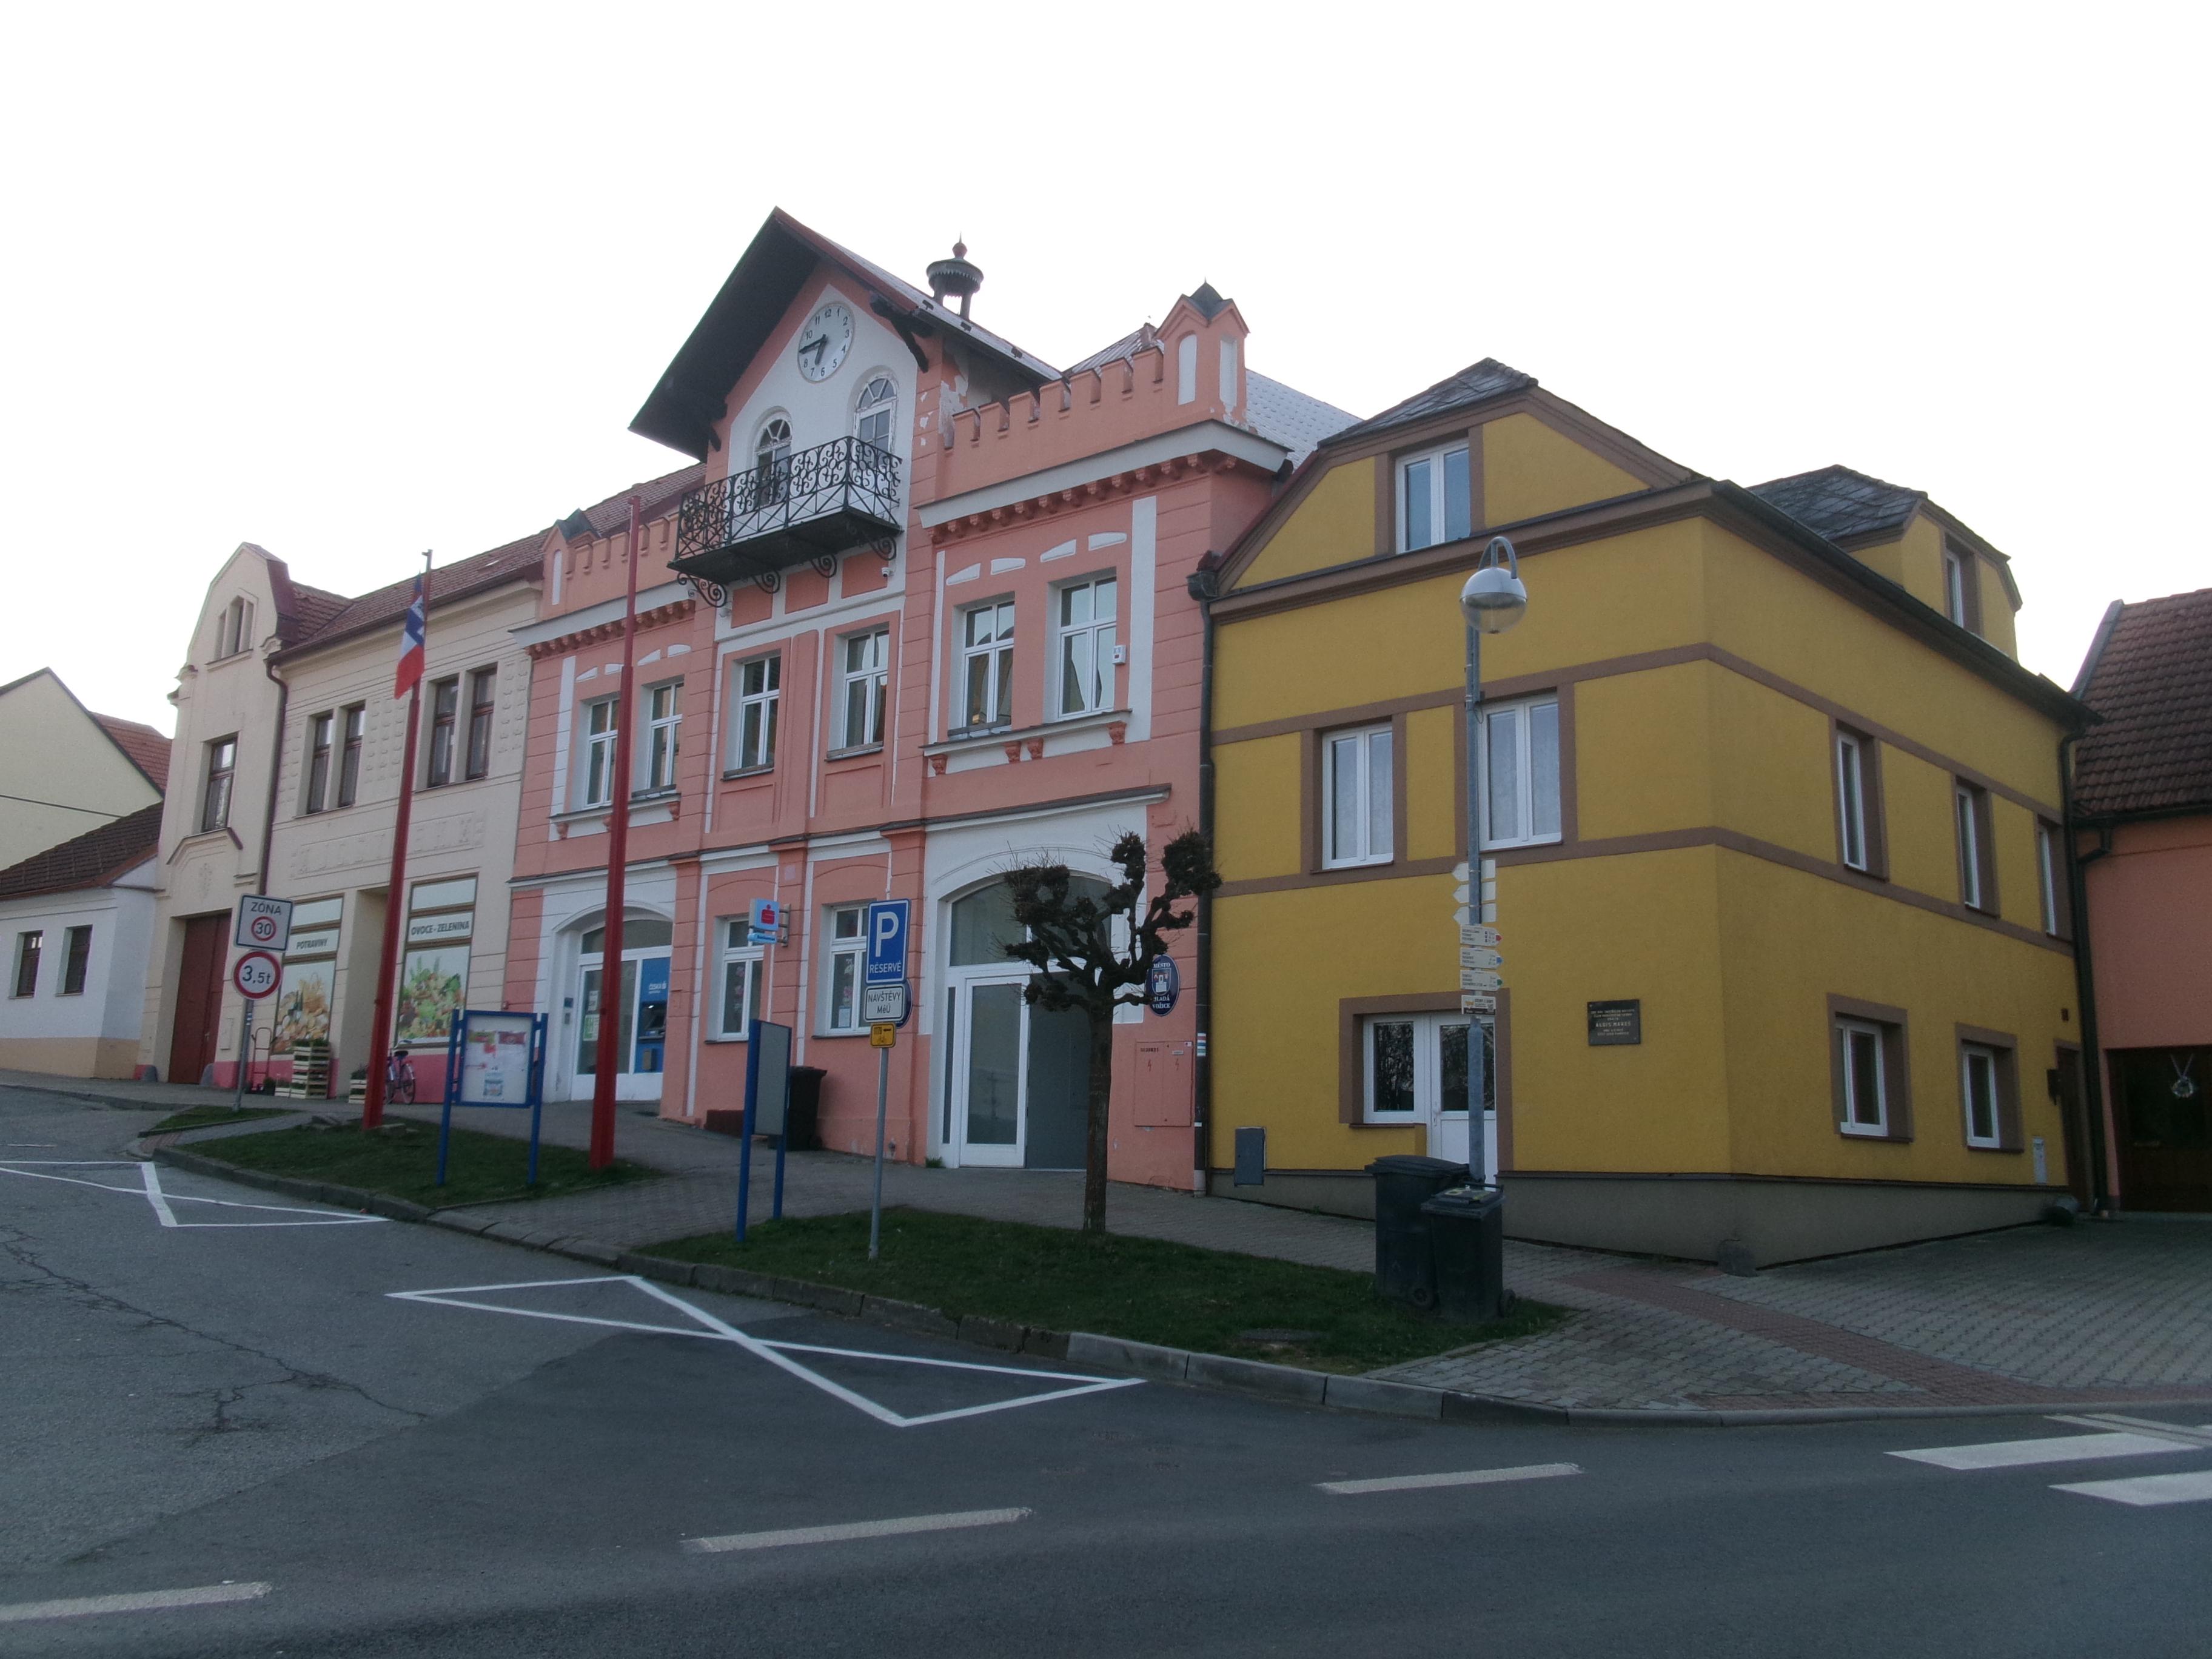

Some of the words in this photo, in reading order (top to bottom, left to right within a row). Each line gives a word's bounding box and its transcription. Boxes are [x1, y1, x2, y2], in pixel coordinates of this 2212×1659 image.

[825, 309, 832, 318] 12
[836, 307, 840, 317] 1
[814, 316, 820, 325] 11
[843, 317, 848, 326] 2
[805, 330, 813, 340] 10
[845, 329, 850, 338] 3
[841, 344, 846, 354] 4
[803, 358, 808, 368] 8
[833, 358, 837, 368] 5
[810, 367, 815, 377] 7
[820, 367, 825, 377] 6
[250, 902, 282, 916] ZÓNA
[255, 922, 272, 936] 30
[411, 925, 433, 936] OVOCE
[437, 920, 470, 933] ZELENINA
[875, 911, 899, 957] P
[296, 938, 329, 950] POTRAVINY
